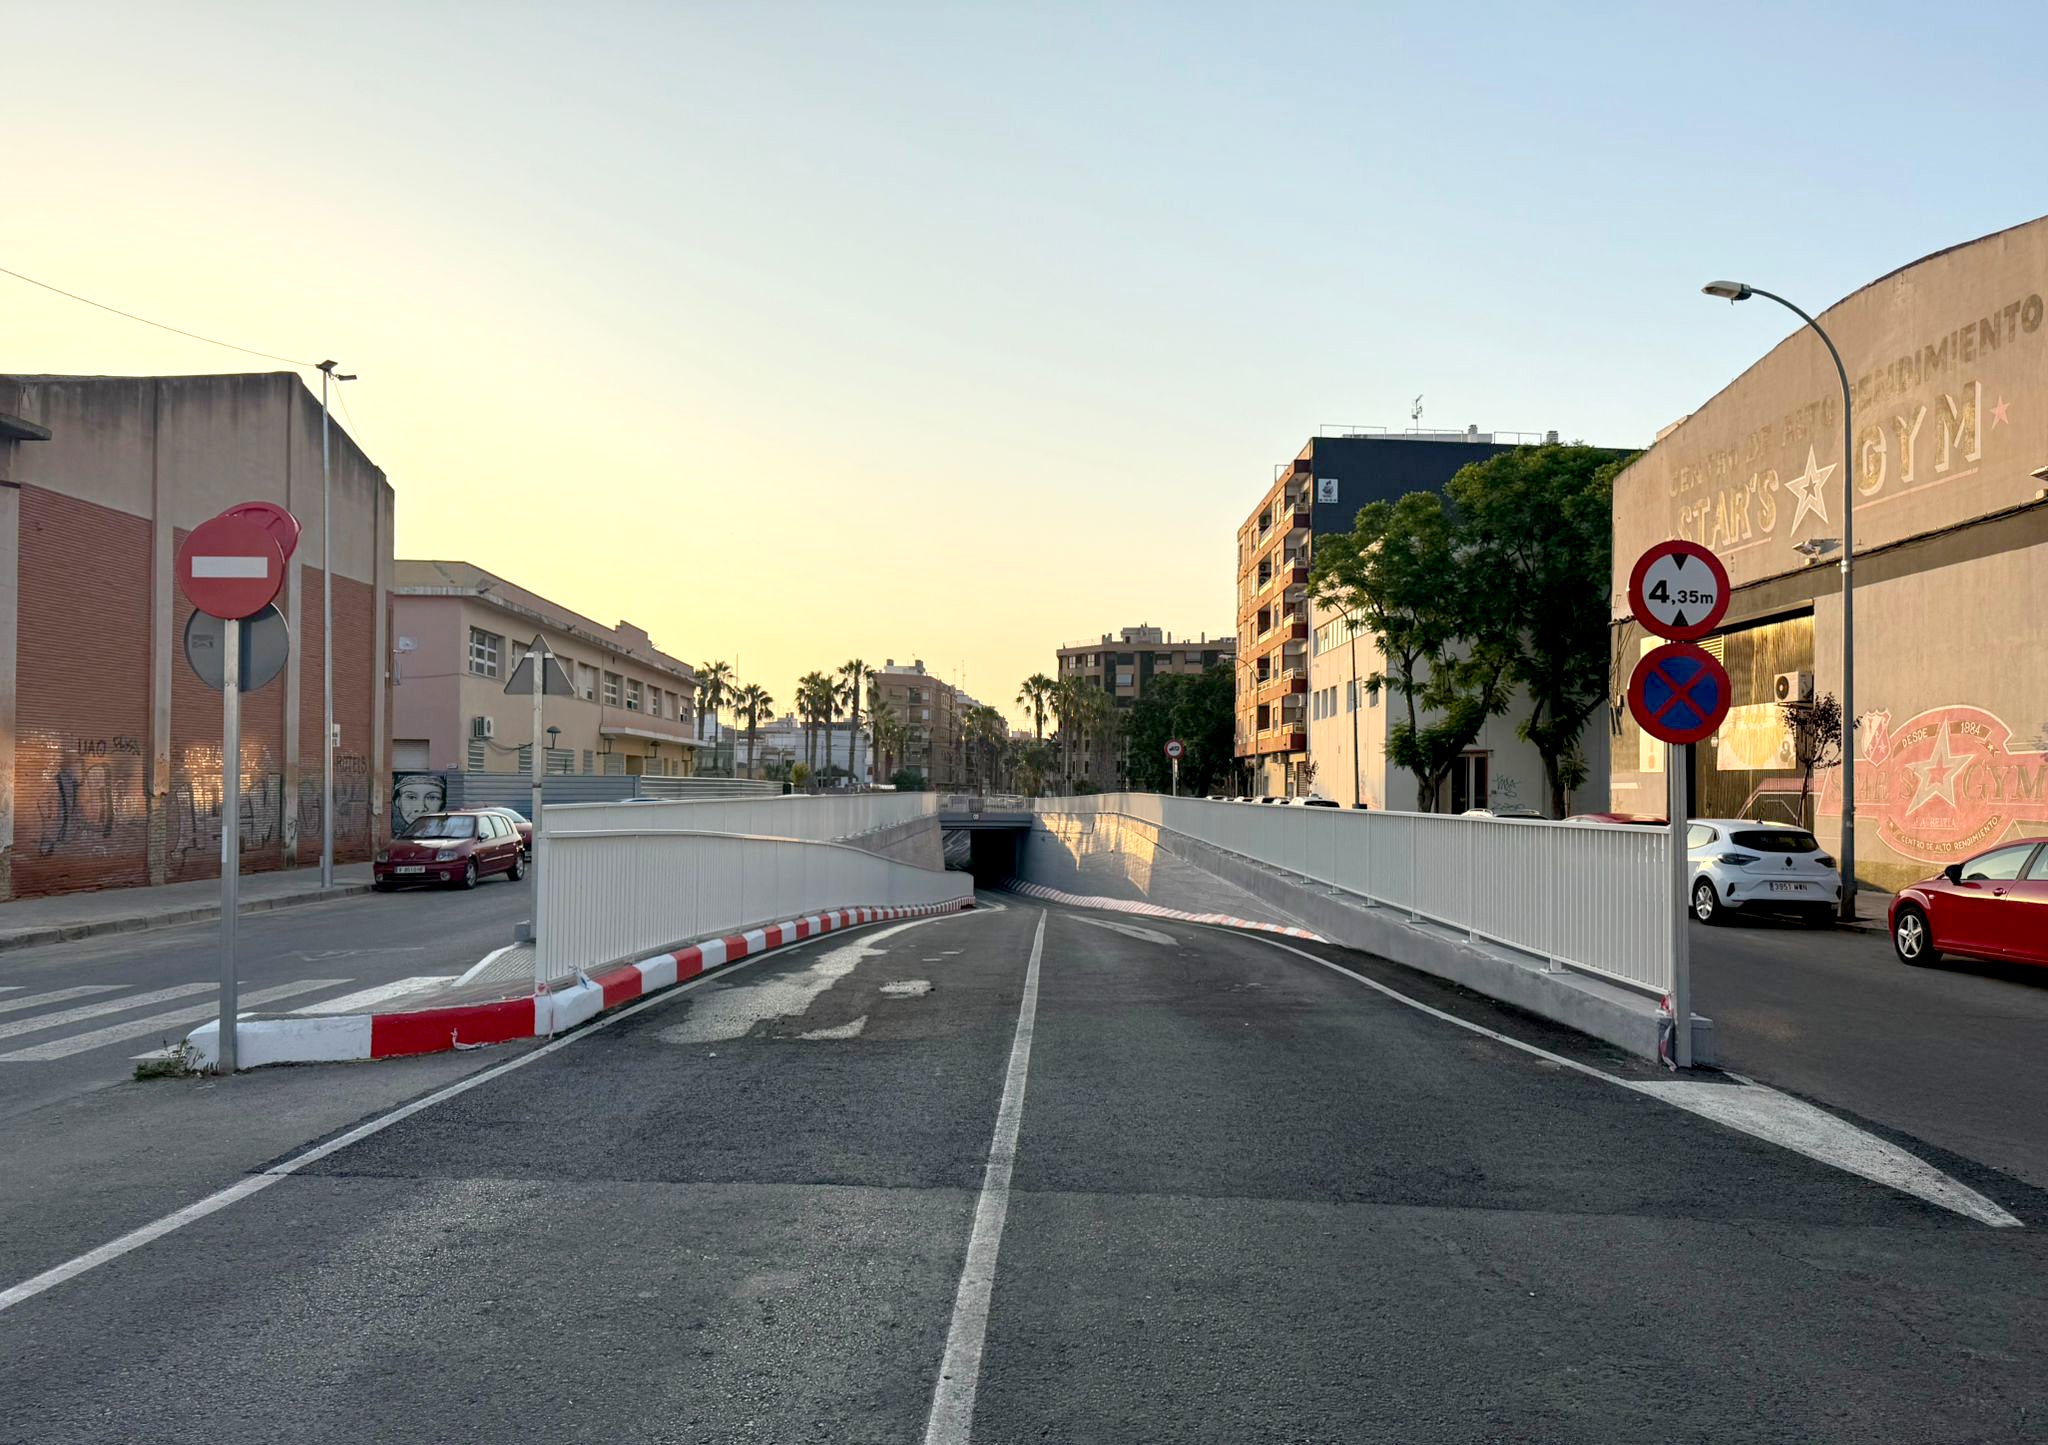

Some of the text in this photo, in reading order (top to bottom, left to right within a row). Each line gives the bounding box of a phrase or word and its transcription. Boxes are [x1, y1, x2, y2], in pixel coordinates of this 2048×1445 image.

[1854, 380, 1982, 497] GYM
[1902, 721, 1981, 748] DESDE 1984
[1901, 835, 1925, 849] CENTRO
[1935, 842, 1952, 852] ALTO
[1953, 816, 1998, 852] RENDIMIENTO
